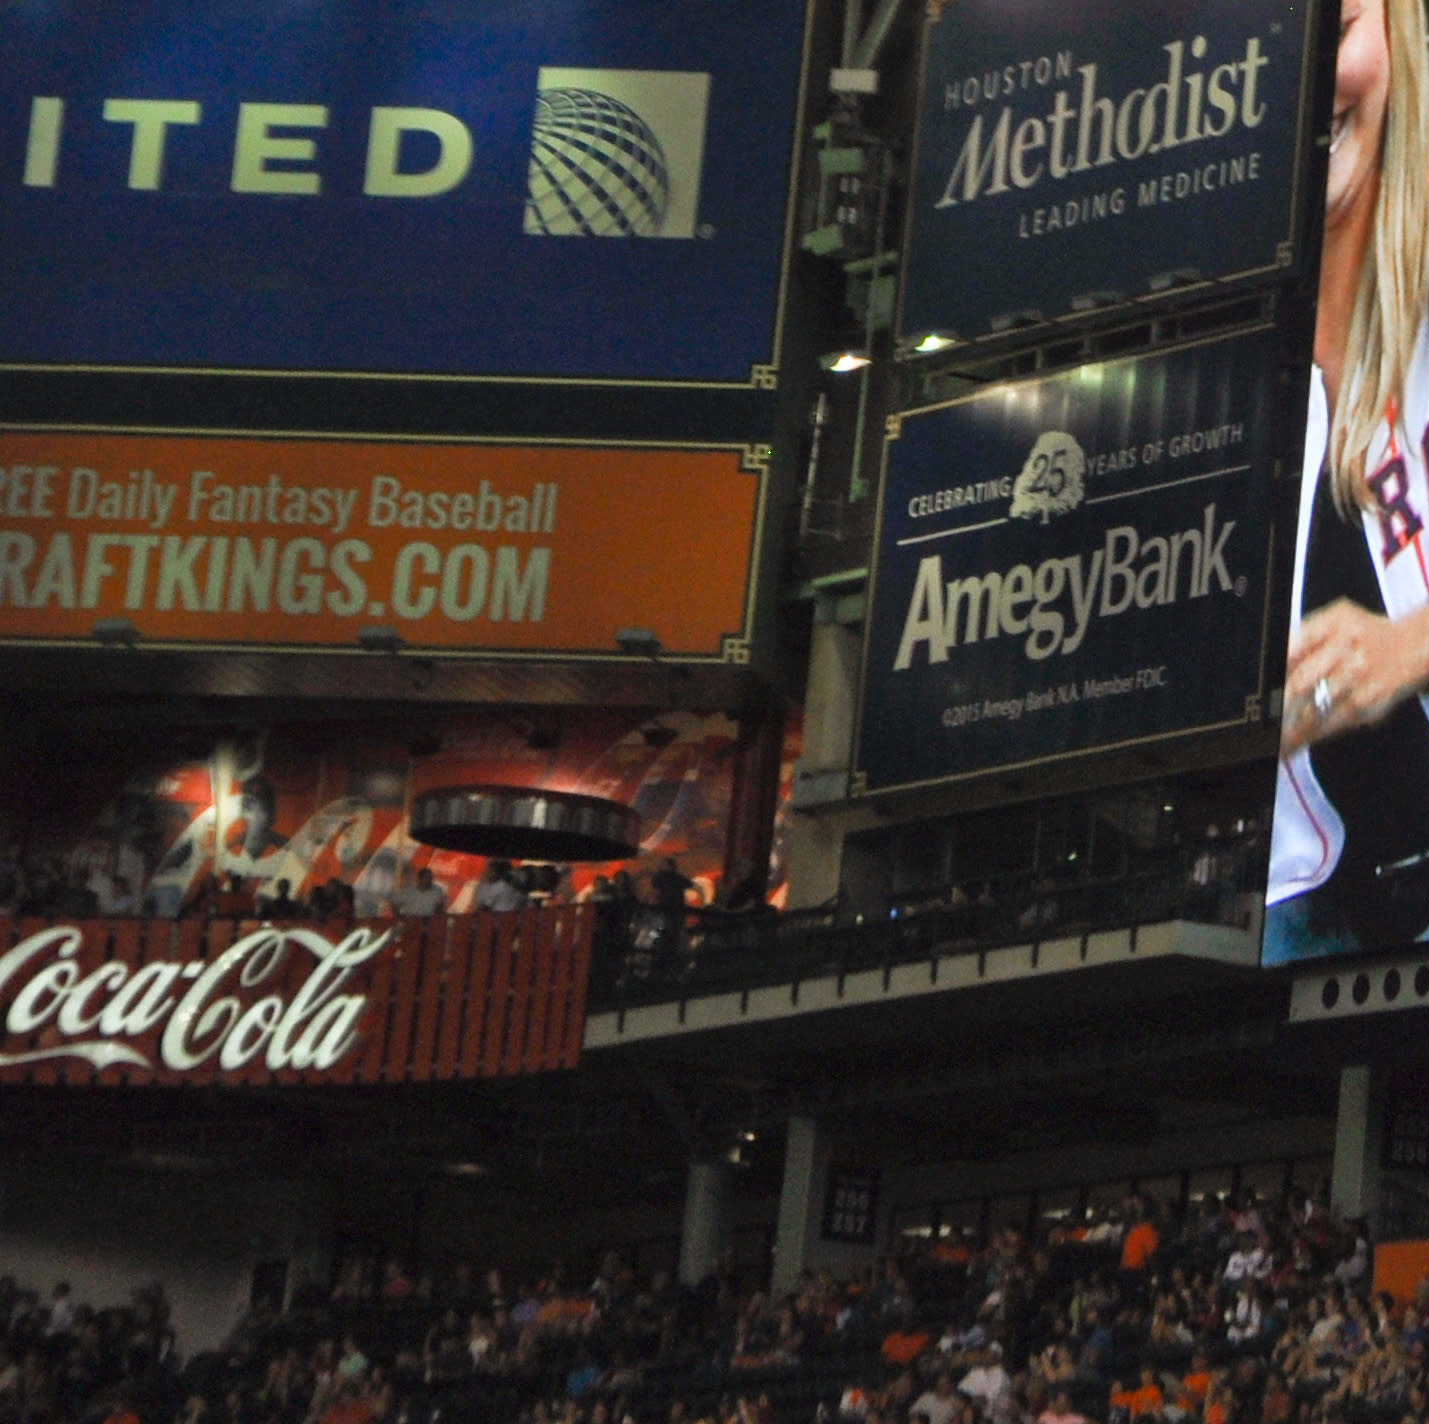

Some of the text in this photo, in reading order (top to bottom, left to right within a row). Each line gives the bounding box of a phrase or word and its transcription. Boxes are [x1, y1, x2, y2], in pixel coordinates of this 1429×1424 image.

[934, 35, 1269, 210] Methodist
[943, 49, 1074, 111] HOUSTON
[23, 95, 476, 199] ITED
[1019, 152, 1262, 238] LEADING MEDICINE
[67, 465, 177, 528] Daily
[187, 469, 360, 534] Fantasy
[367, 474, 560, 534] Baseball
[908, 423, 1244, 519] CELEBRATING 25 YEARS OF GROWTH
[0, 529, 553, 623] RAFTKINGS.COM
